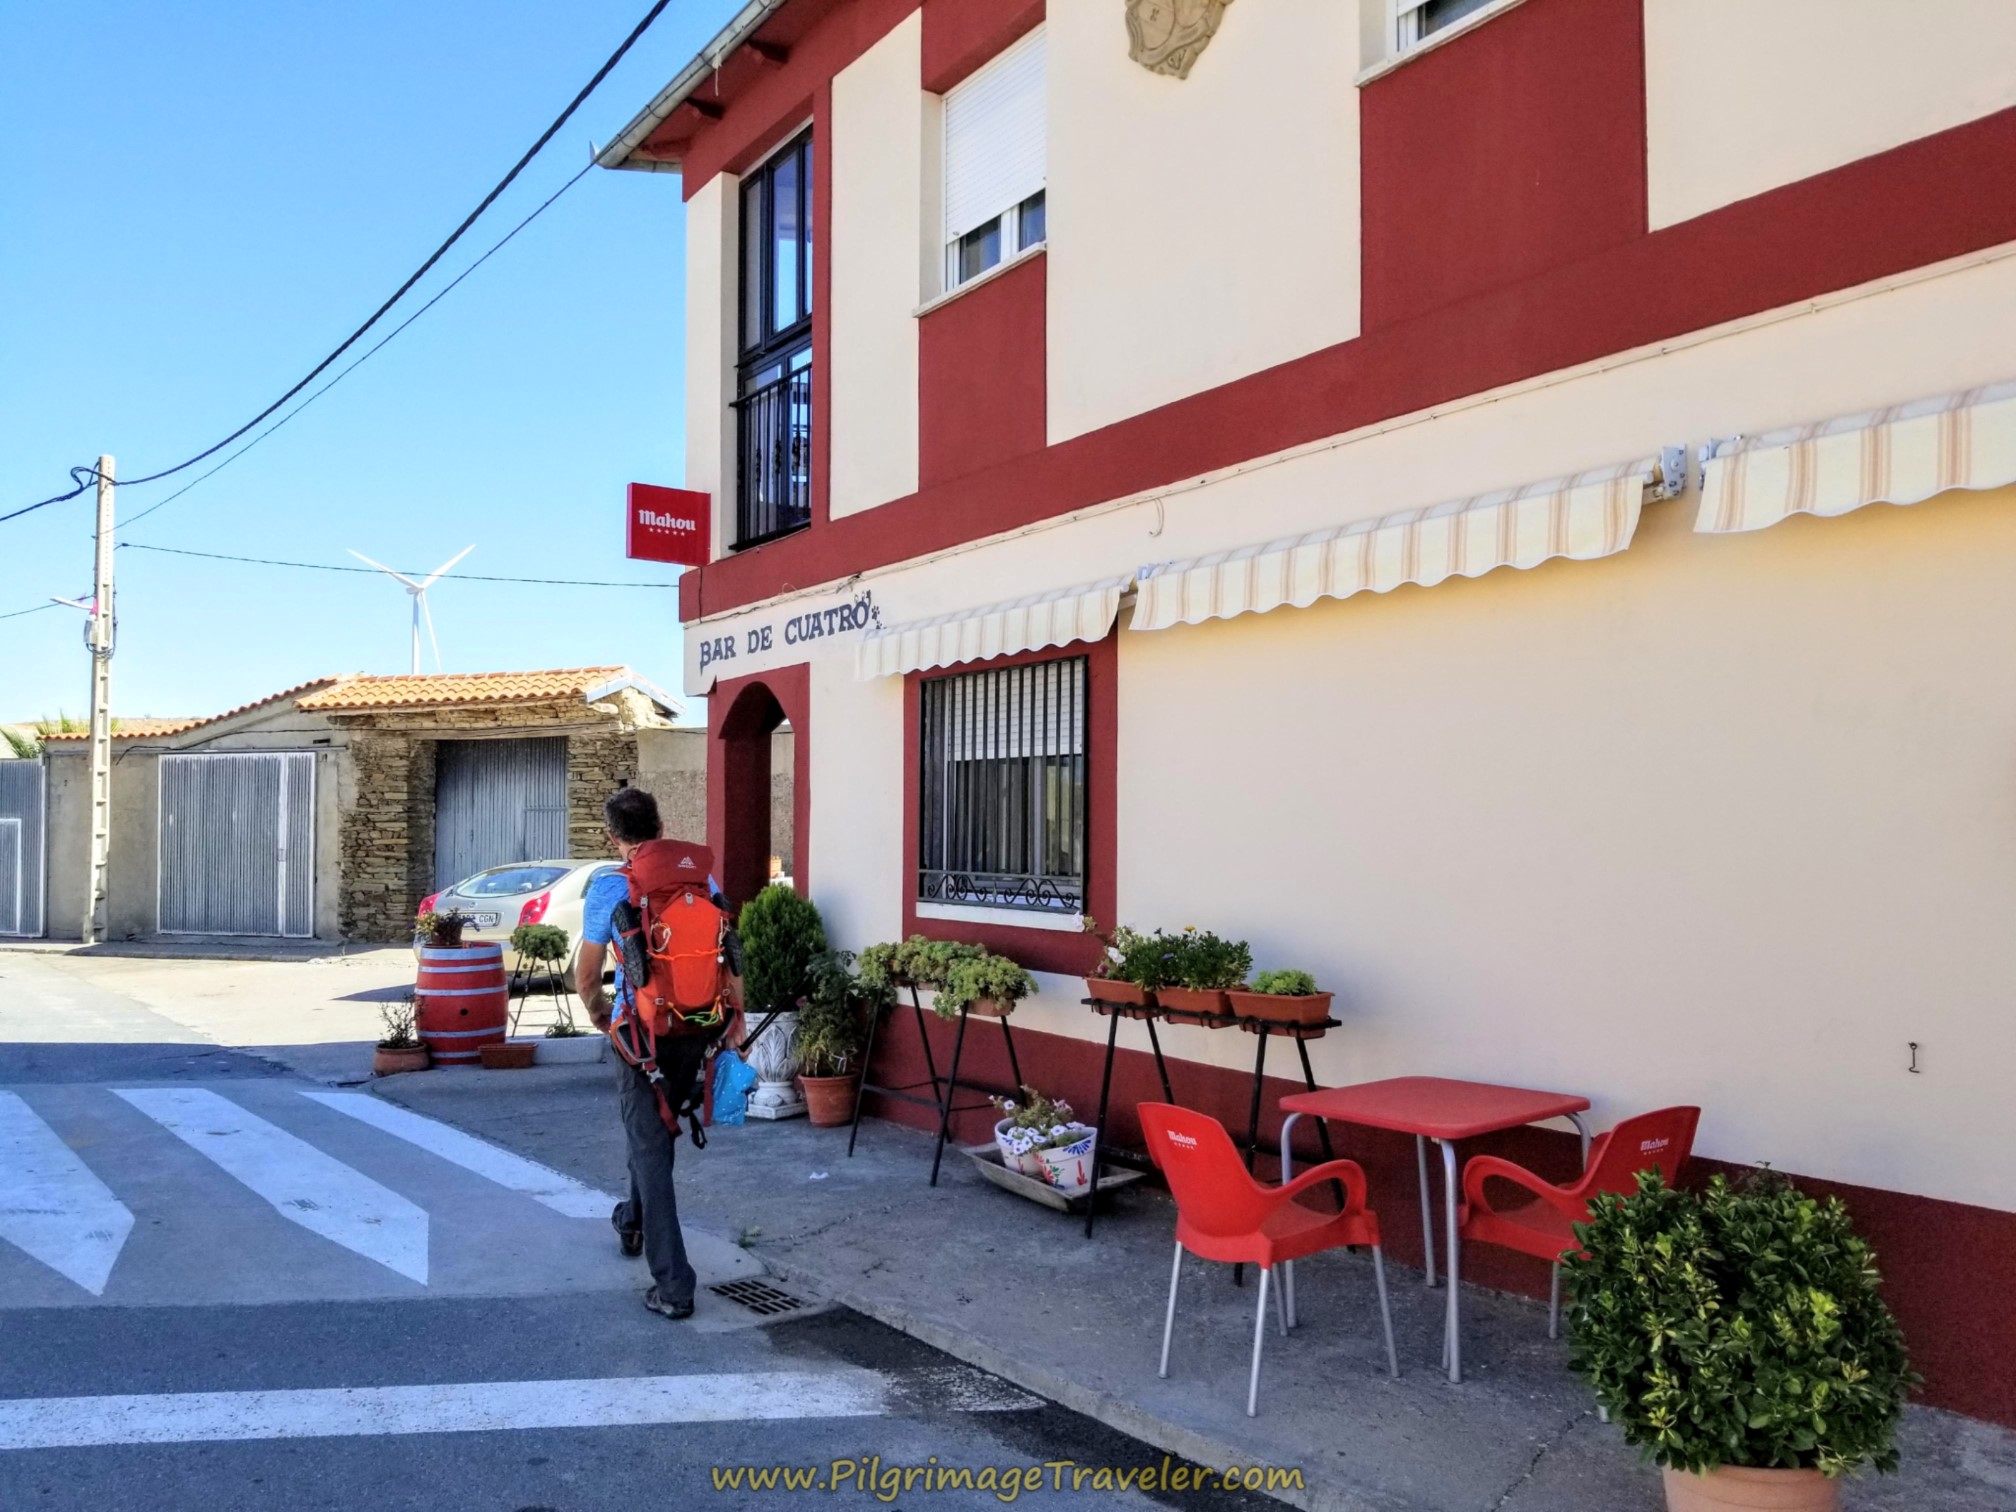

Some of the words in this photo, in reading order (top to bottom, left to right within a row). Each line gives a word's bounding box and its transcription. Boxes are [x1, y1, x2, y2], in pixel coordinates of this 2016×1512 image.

[638, 509, 696, 531] Mahou
[699, 635, 736, 676] BAR
[747, 625, 773, 654] DE
[784, 599, 870, 645] CUATRO
[478, 914, 494, 923] CGN
